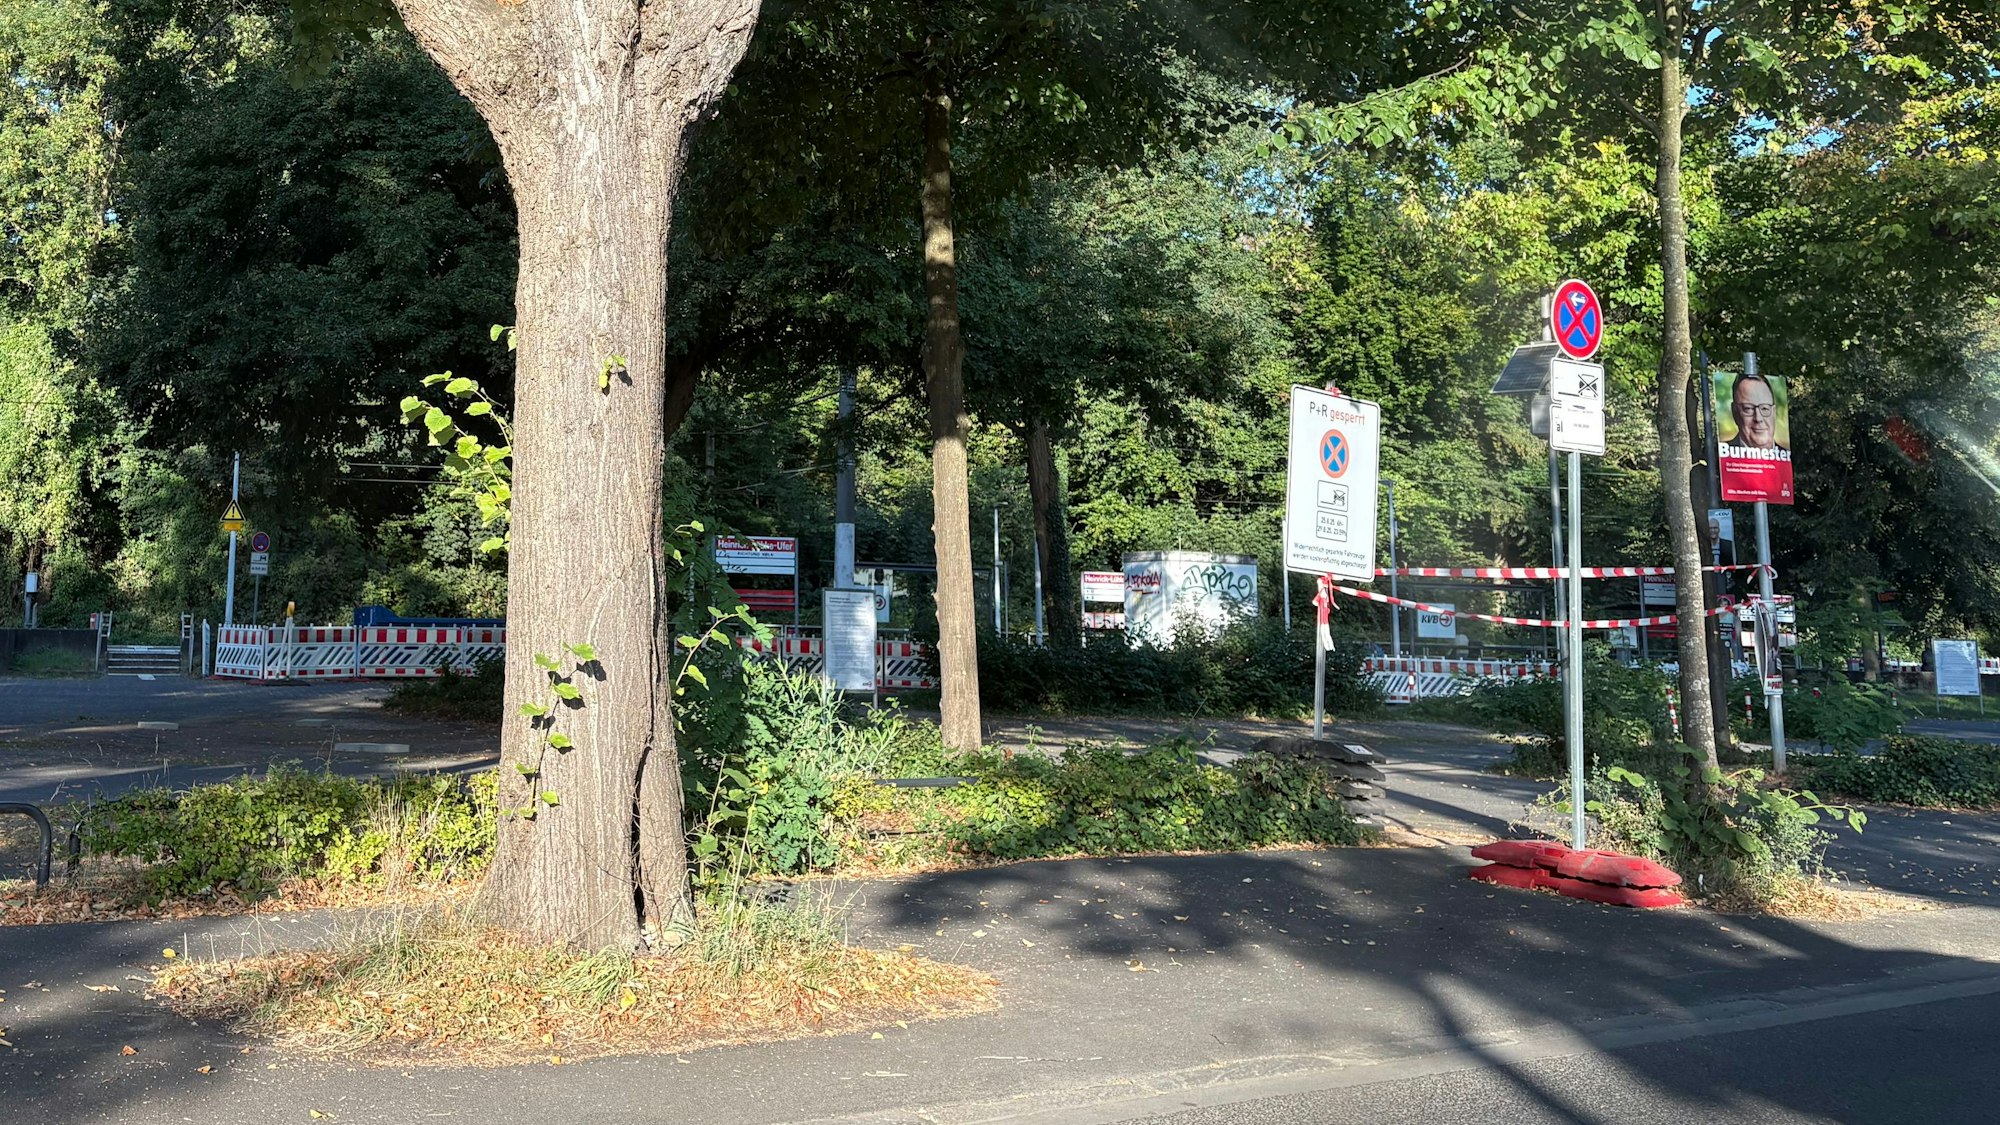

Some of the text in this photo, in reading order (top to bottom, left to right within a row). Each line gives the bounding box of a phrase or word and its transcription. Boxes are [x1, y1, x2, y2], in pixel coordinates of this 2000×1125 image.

[1309, 401, 1365, 425] P+R gesperrt
[1719, 442, 1792, 461] Burmester
[1344, 550, 1365, 560] Fahrzeuge
[1421, 614, 1439, 624] KVB
